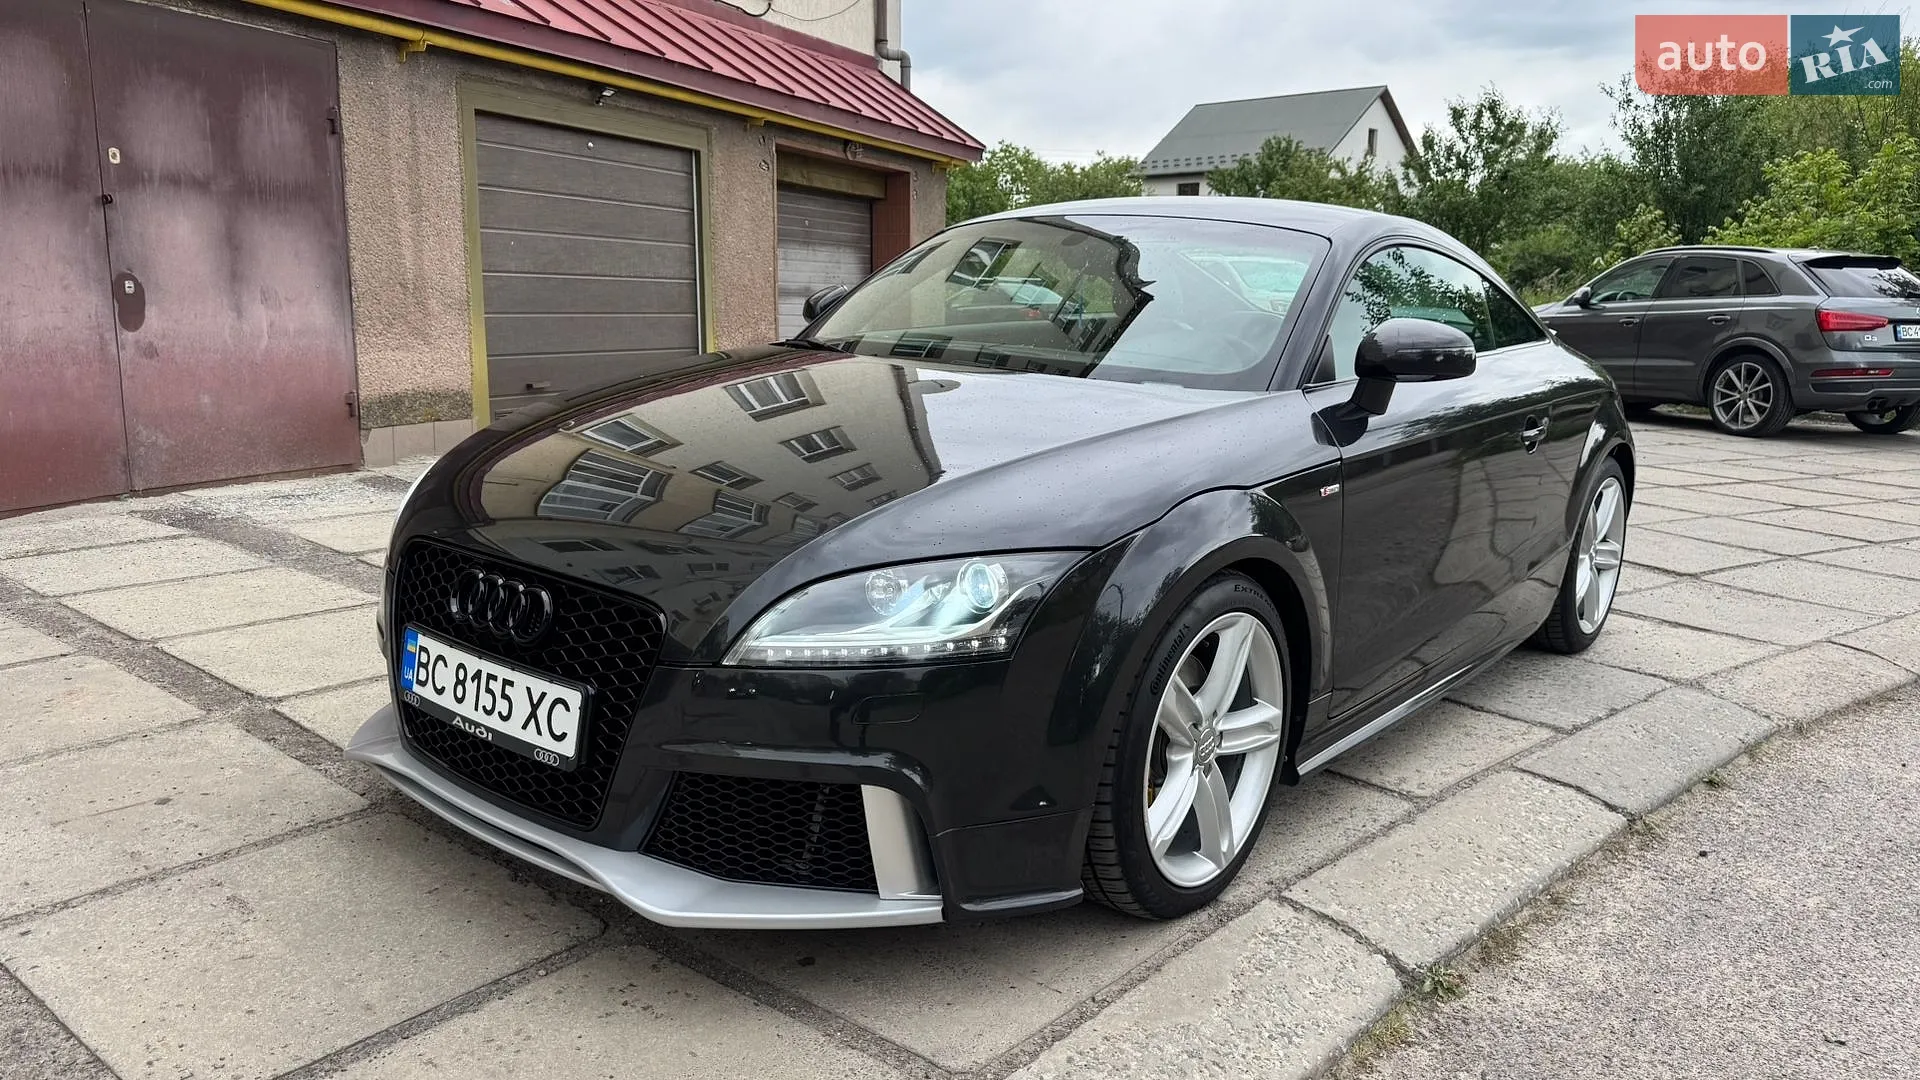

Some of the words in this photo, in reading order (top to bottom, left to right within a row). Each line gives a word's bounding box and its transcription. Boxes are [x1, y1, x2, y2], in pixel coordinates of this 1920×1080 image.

[403, 666, 413, 681] UA
[1150, 628, 1187, 696] Continental
[415, 645, 448, 696] BC
[453, 662, 515, 723] 8155
[521, 686, 571, 743] XC
[452, 715, 493, 741] Audi
